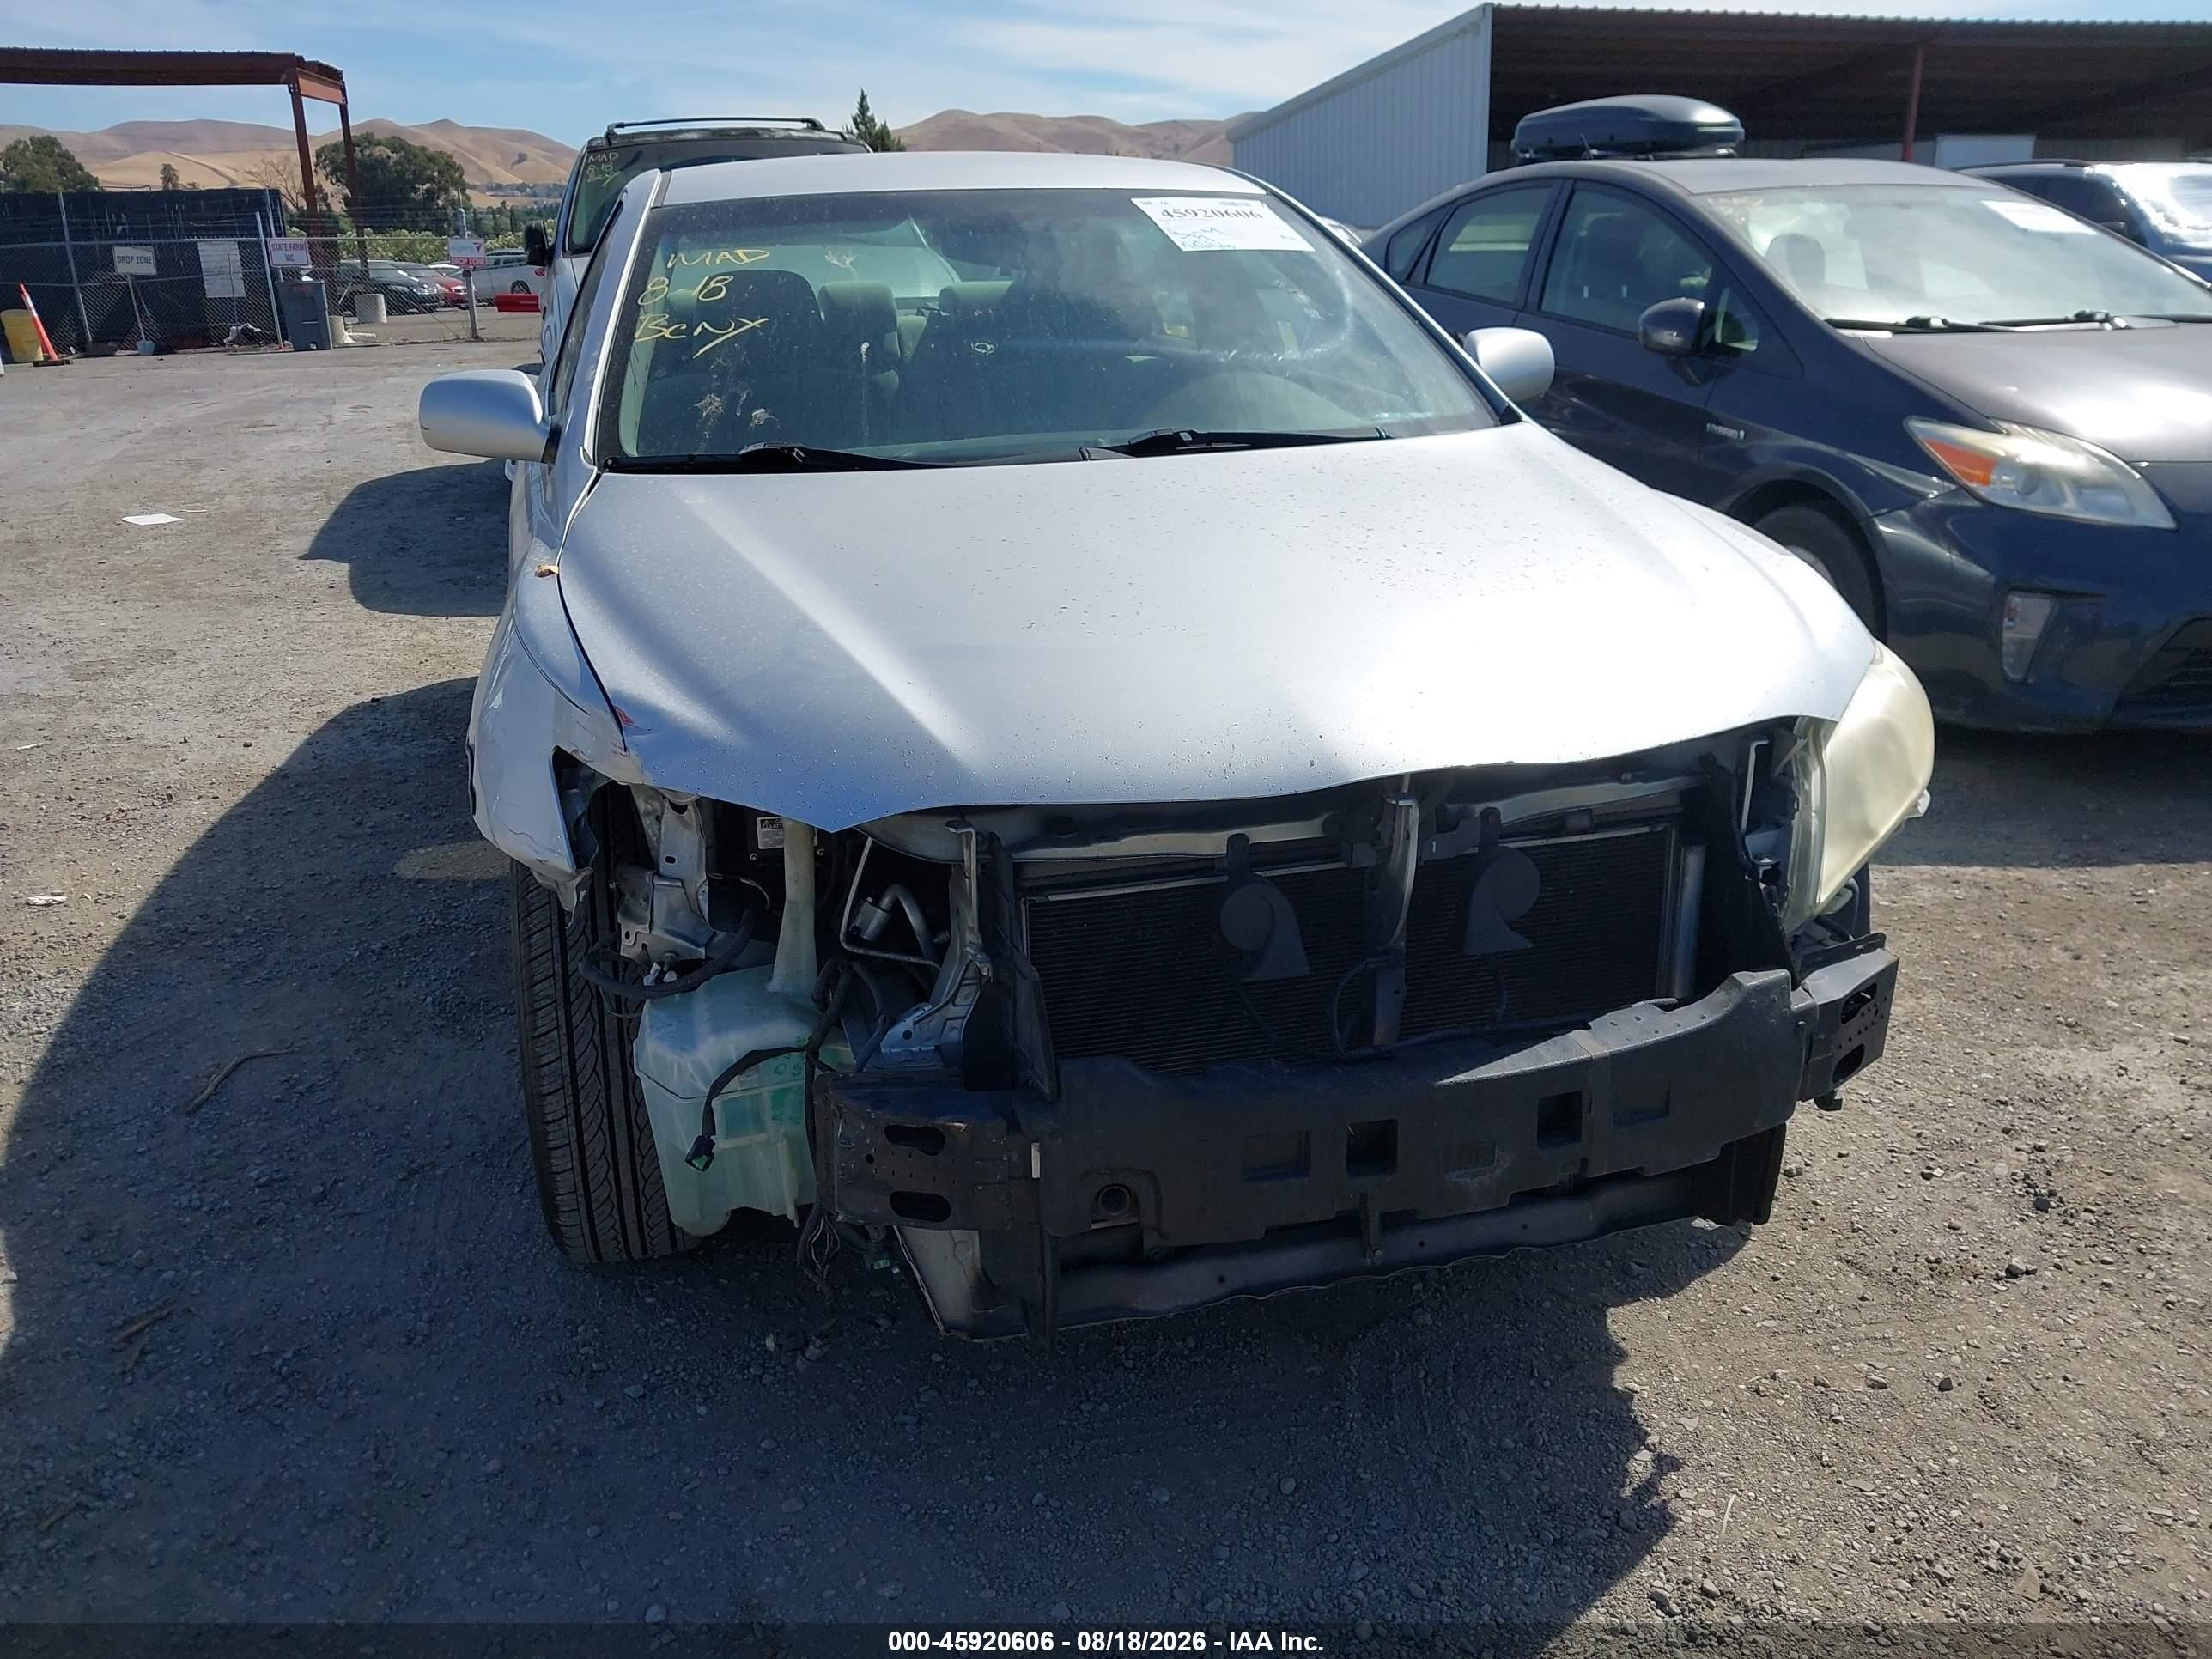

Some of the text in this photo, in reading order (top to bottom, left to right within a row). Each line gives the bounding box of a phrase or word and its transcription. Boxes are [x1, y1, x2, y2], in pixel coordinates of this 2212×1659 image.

[270, 242, 304, 252] STATE FARM
[117, 255, 152, 264] DROP ZONE
